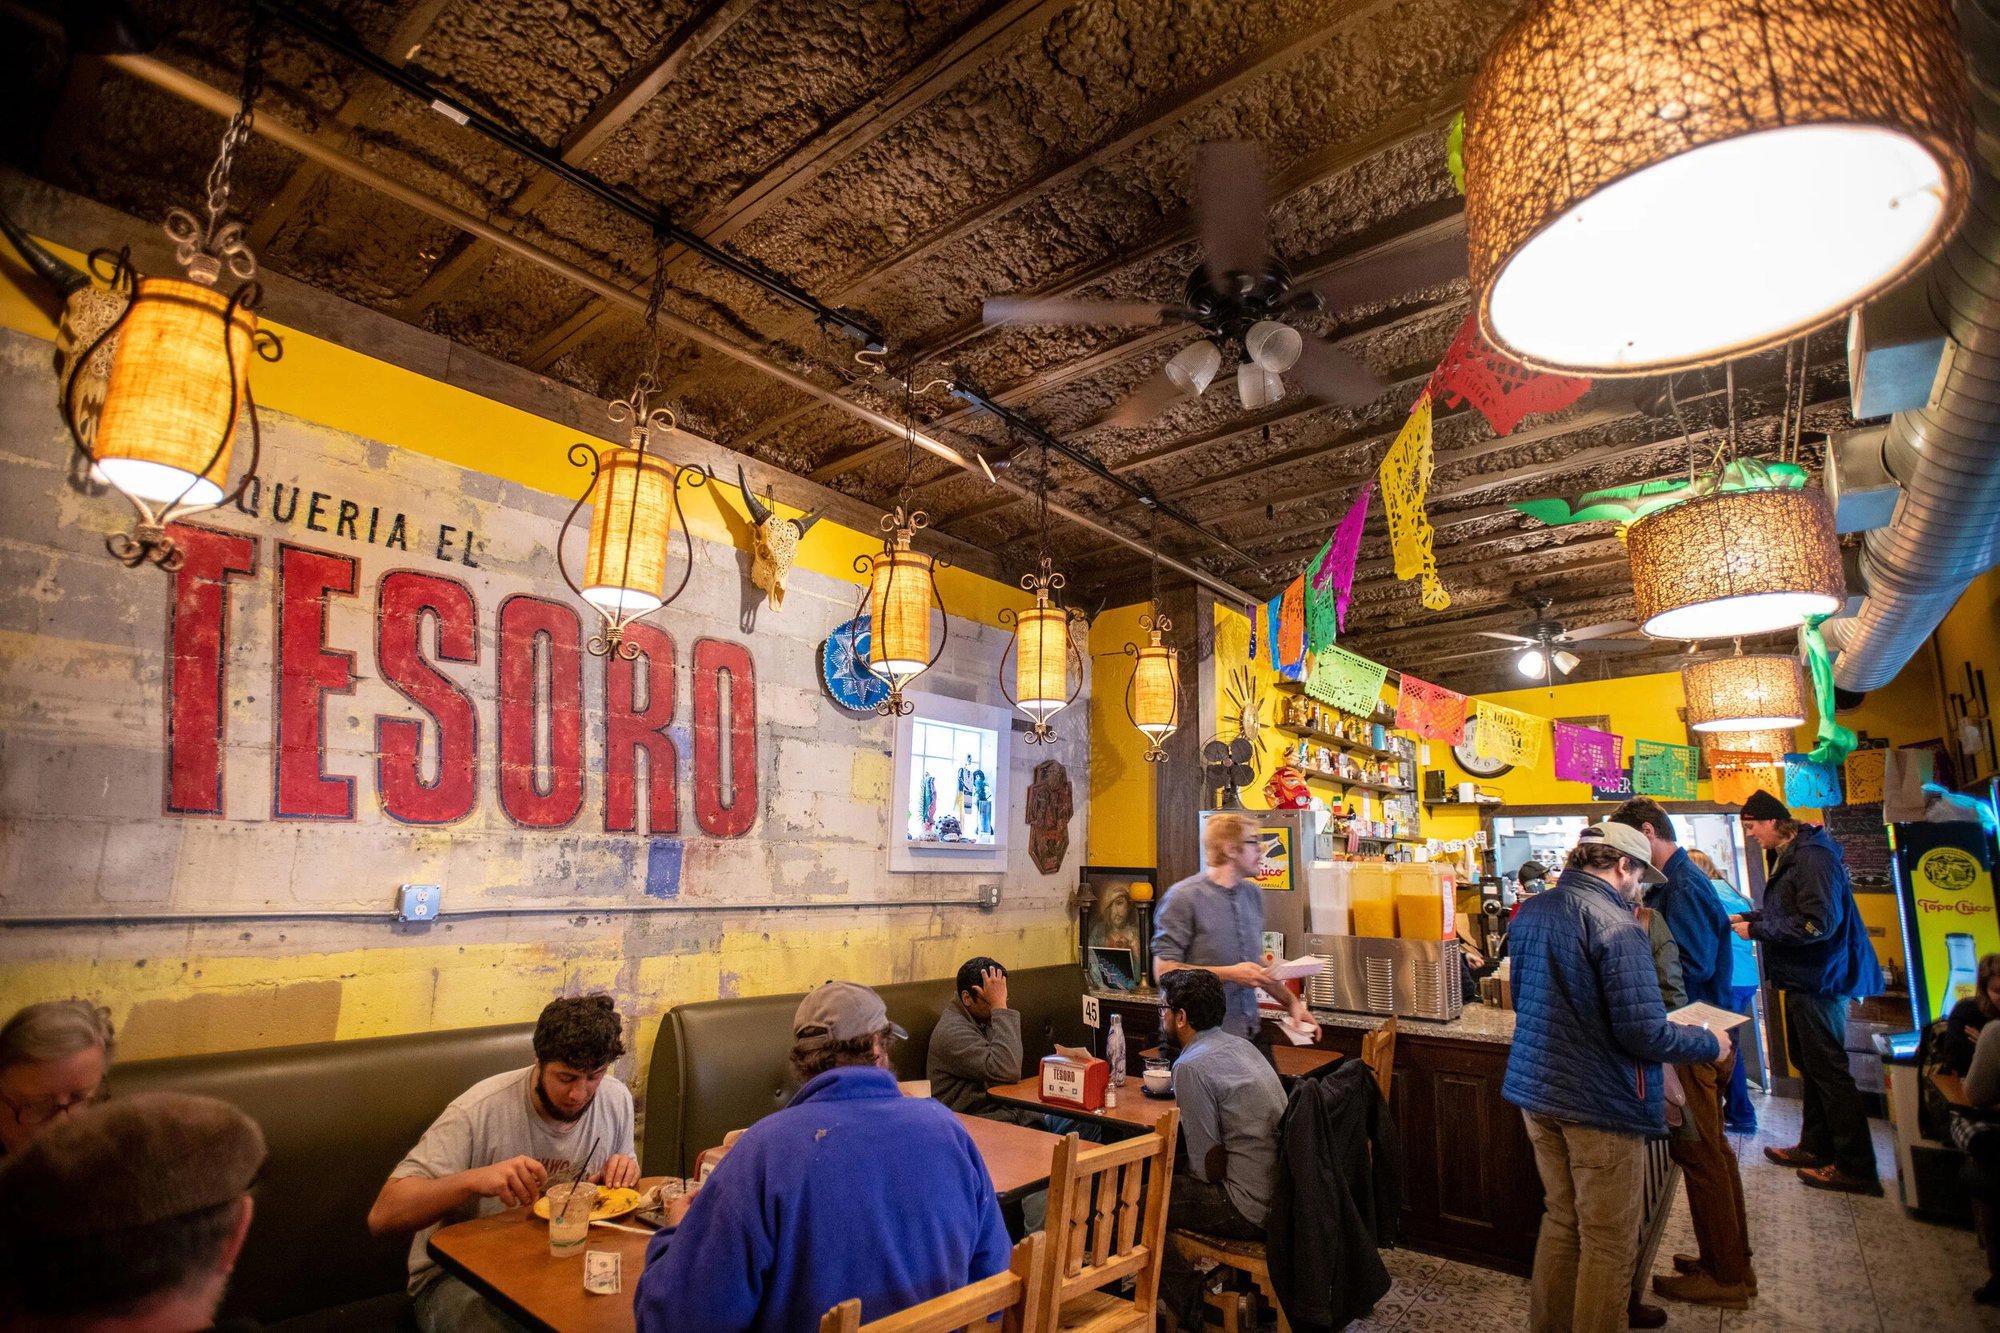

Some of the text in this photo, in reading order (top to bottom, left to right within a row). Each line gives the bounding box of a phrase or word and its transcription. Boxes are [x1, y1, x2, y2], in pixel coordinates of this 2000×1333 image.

[234, 473, 479, 568] QUERIA EL
[162, 520, 758, 840] TESORO
[1917, 898, 1994, 915] Topo Chico
[1085, 1000, 1097, 1022] 45
[1053, 1068, 1075, 1083] TESORO
